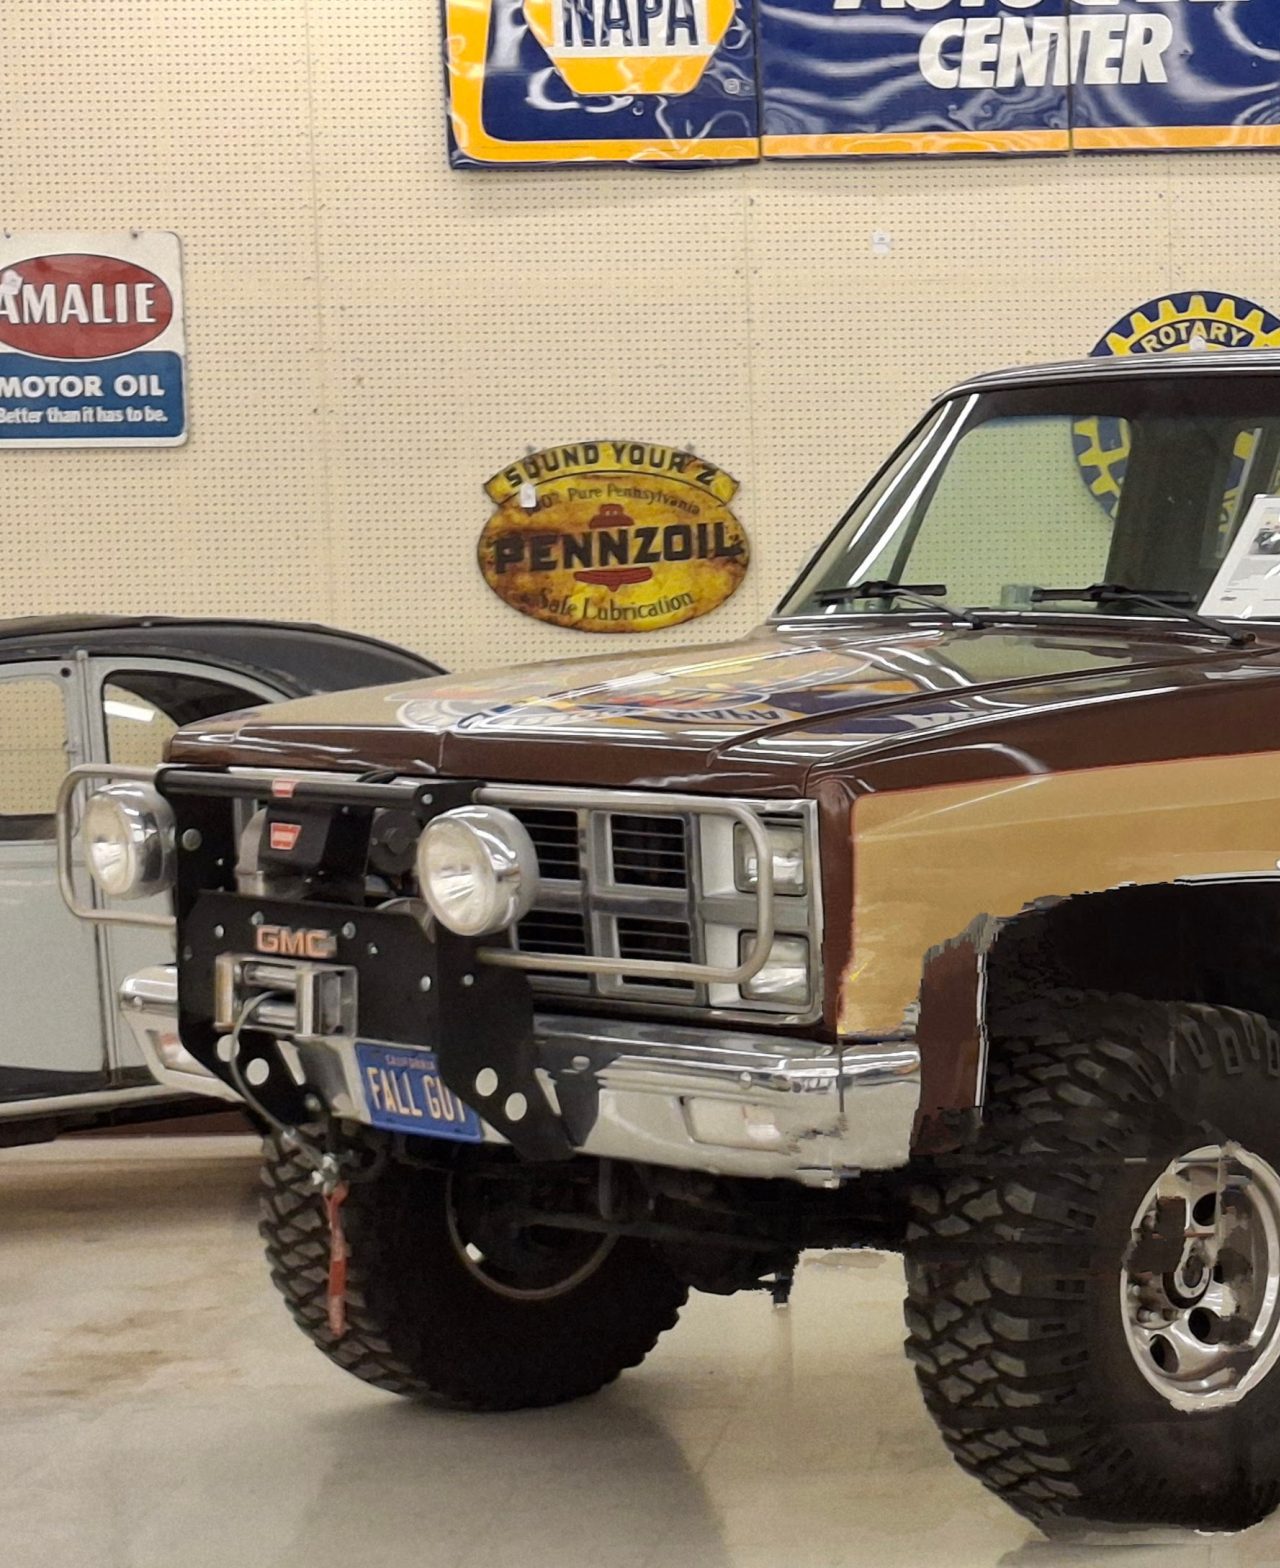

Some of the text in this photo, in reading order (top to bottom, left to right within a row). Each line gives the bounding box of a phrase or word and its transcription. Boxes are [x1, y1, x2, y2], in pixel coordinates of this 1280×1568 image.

[562, 0, 699, 47] NAPA
[919, 13, 1173, 89] CENTER
[1143, 320, 1248, 353] ROTARY
[0, 374, 166, 398] MOTOR OIL
[46, 406, 81, 423] than
[82, 406, 94, 422] it
[96, 406, 124, 422] has
[126, 406, 142, 422] to
[144, 405, 169, 422] be.
[505, 443, 600, 487] SOUND
[611, 443, 690, 474] YOUR
[568, 487, 603, 502] Pure
[607, 483, 701, 515] Pennsylvania
[493, 522, 745, 574] PENNZOIL
[583, 592, 694, 621] Lubrication
[256, 926, 337, 958] GMC
[366, 1066, 423, 1117] FALL
